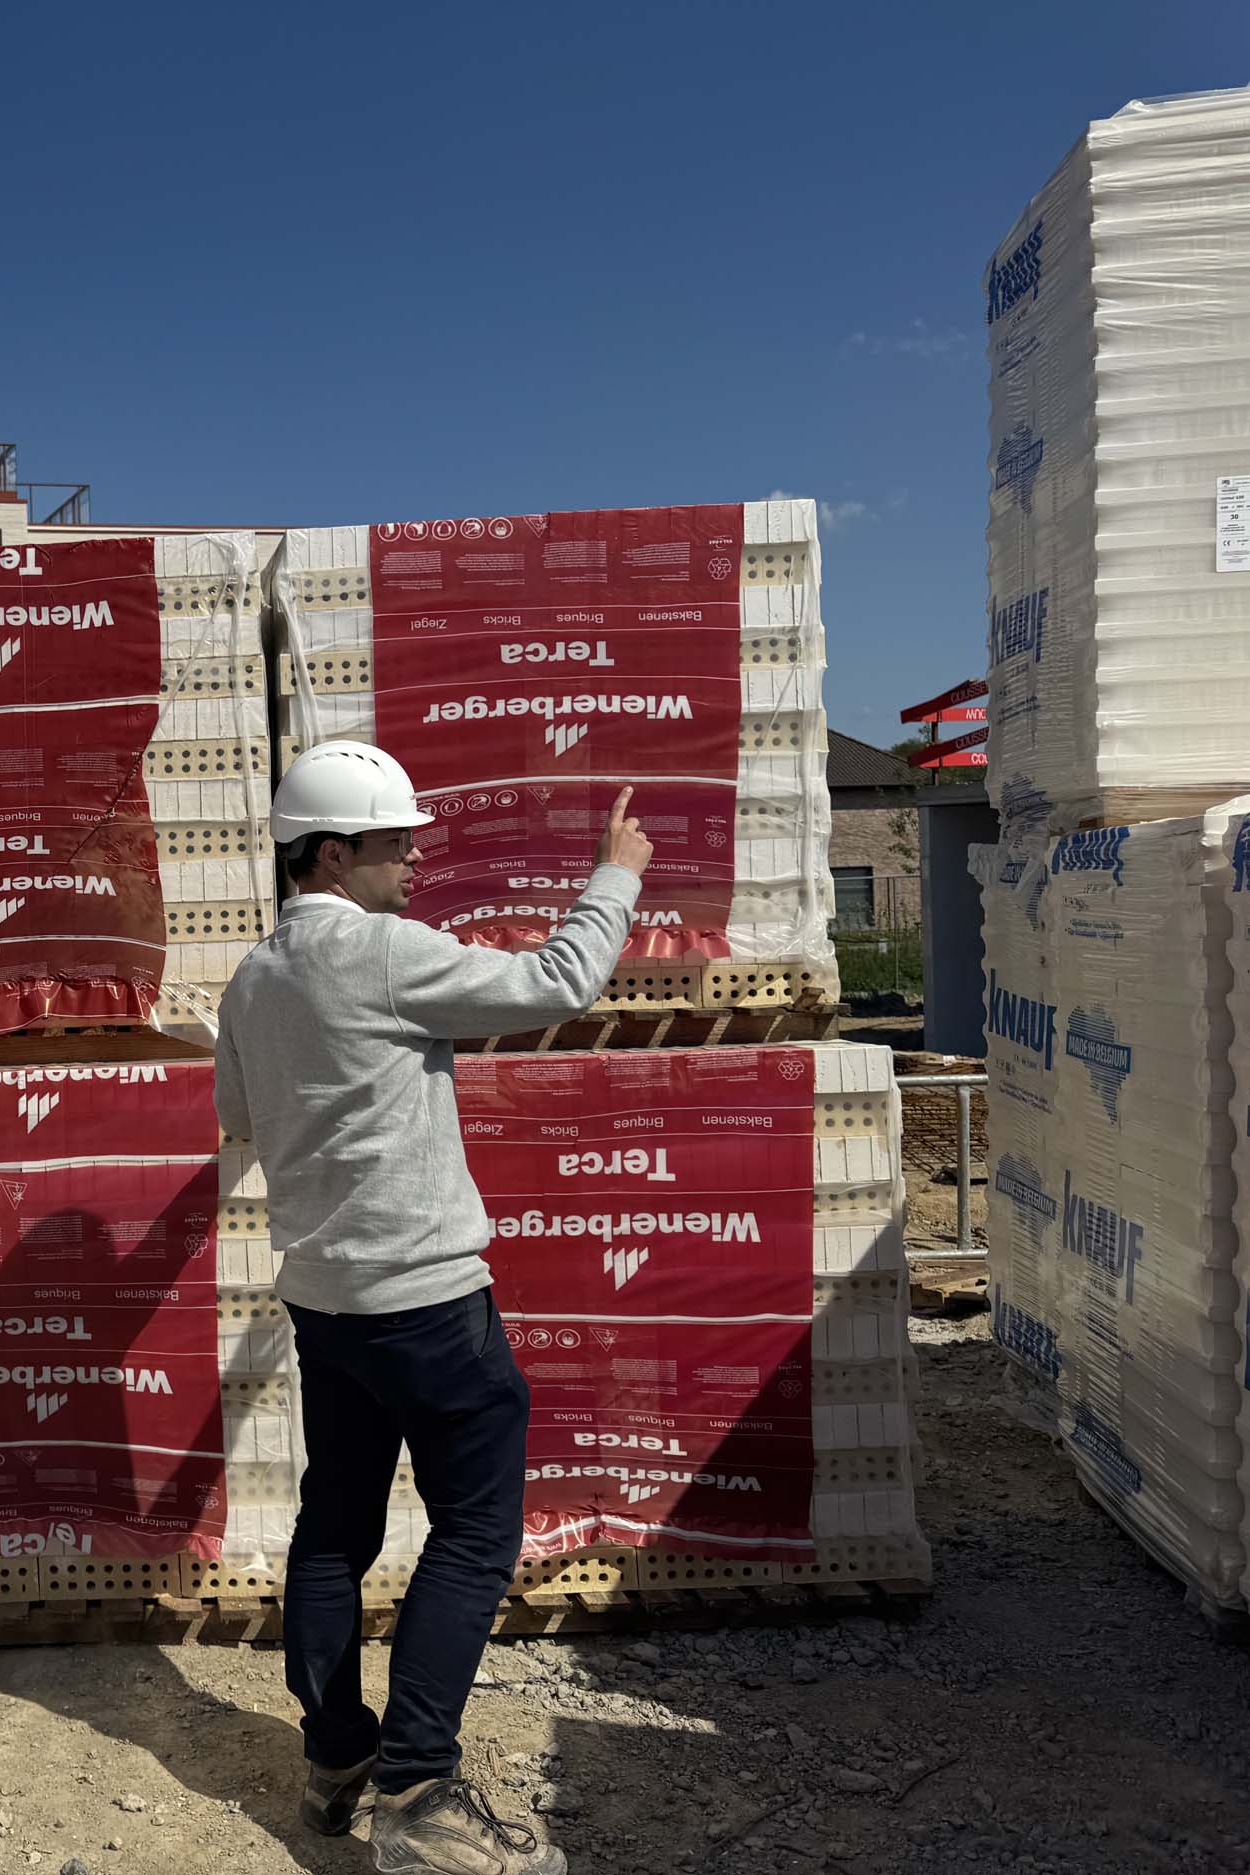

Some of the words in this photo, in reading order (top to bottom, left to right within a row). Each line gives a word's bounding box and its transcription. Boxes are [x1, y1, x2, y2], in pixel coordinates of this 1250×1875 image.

[483, 614, 521, 626] Bricks
[556, 613, 604, 625] Briques
[638, 610, 702, 622] Bakstenen
[410, 618, 448, 631] Ziegel
[500, 640, 615, 667] Terca
[423, 695, 694, 724] Wienerberger
[489, 859, 527, 871] Bricks
[508, 876, 588, 891] erca
[988, 967, 1058, 1072] KNAUF
[613, 1115, 665, 1130] Briques
[701, 1115, 774, 1129] Bakstenen
[463, 1123, 504, 1137] Ziegel
[540, 1124, 580, 1137] Bricks
[557, 1148, 677, 1182] Terca
[1062, 1168, 1144, 1305] KNAUF
[34, 1287, 81, 1301] Briques
[115, 1289, 179, 1302] Bakstenen
[553, 1412, 593, 1422] Bricks
[628, 1414, 676, 1428] Briques
[709, 1419, 774, 1431] Bakstenen
[573, 1432, 688, 1457] Terca
[524, 1464, 763, 1493] Wienerberge
[49, 1505, 93, 1517] Briques
[126, 1514, 188, 1529] Bakstenen
